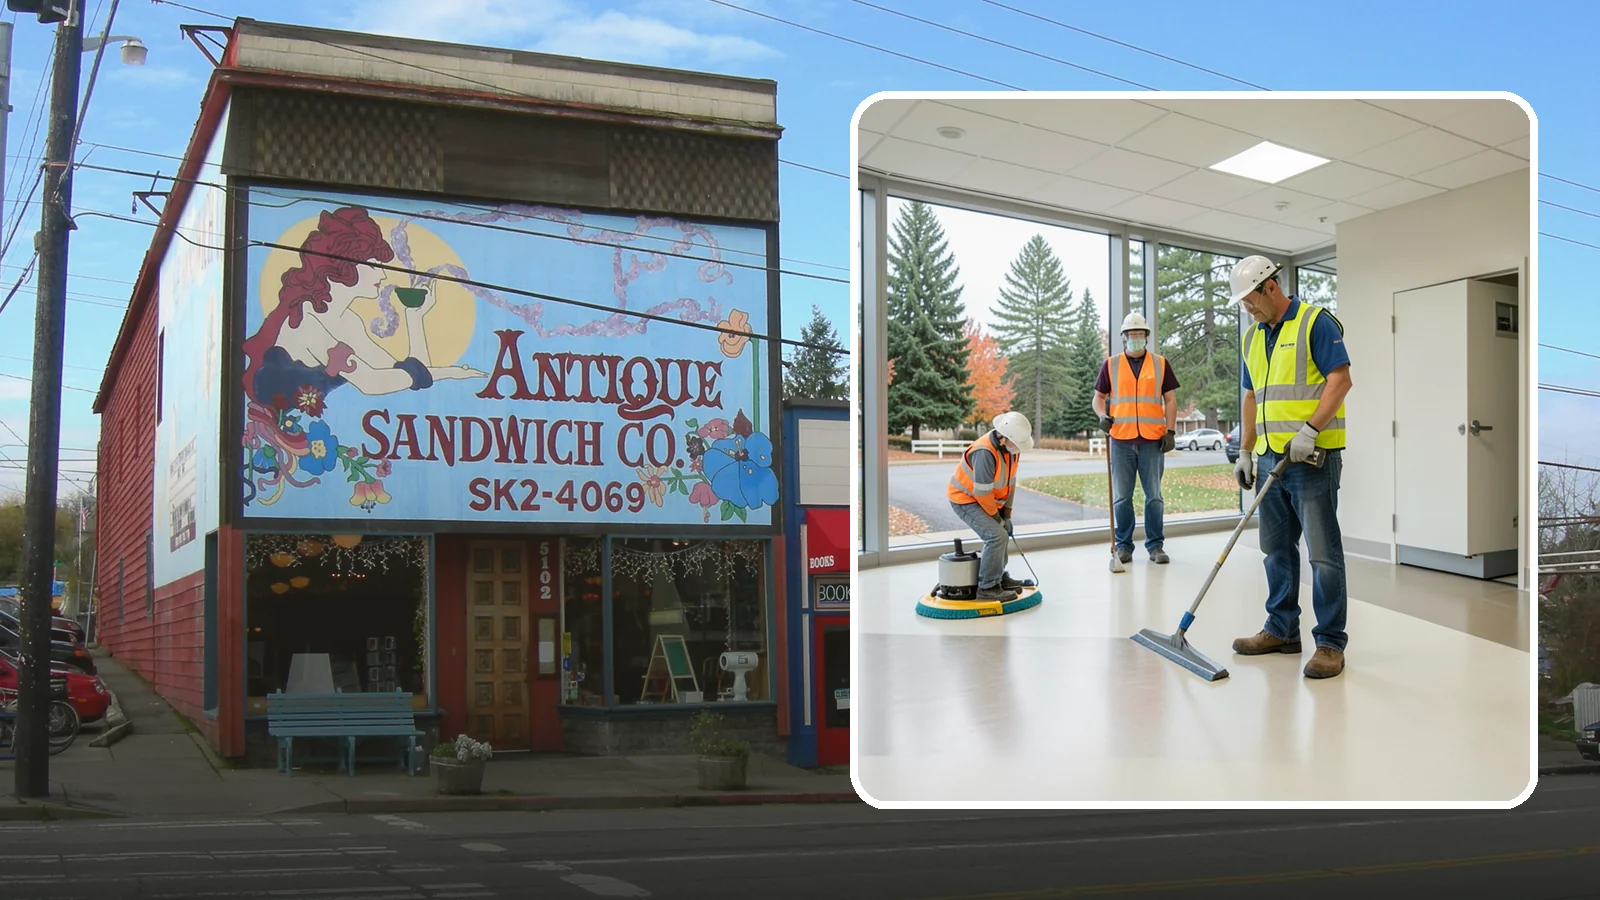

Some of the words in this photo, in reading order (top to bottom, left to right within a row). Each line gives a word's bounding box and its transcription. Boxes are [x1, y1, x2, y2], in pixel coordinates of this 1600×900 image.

[476, 329, 723, 421] ANTIQUE
[361, 408, 604, 467] SANDWICH
[617, 421, 685, 469] CO.
[468, 476, 645, 513] SK2-4069
[539, 542, 552, 600] 5102
[809, 555, 835, 569] BOOKS
